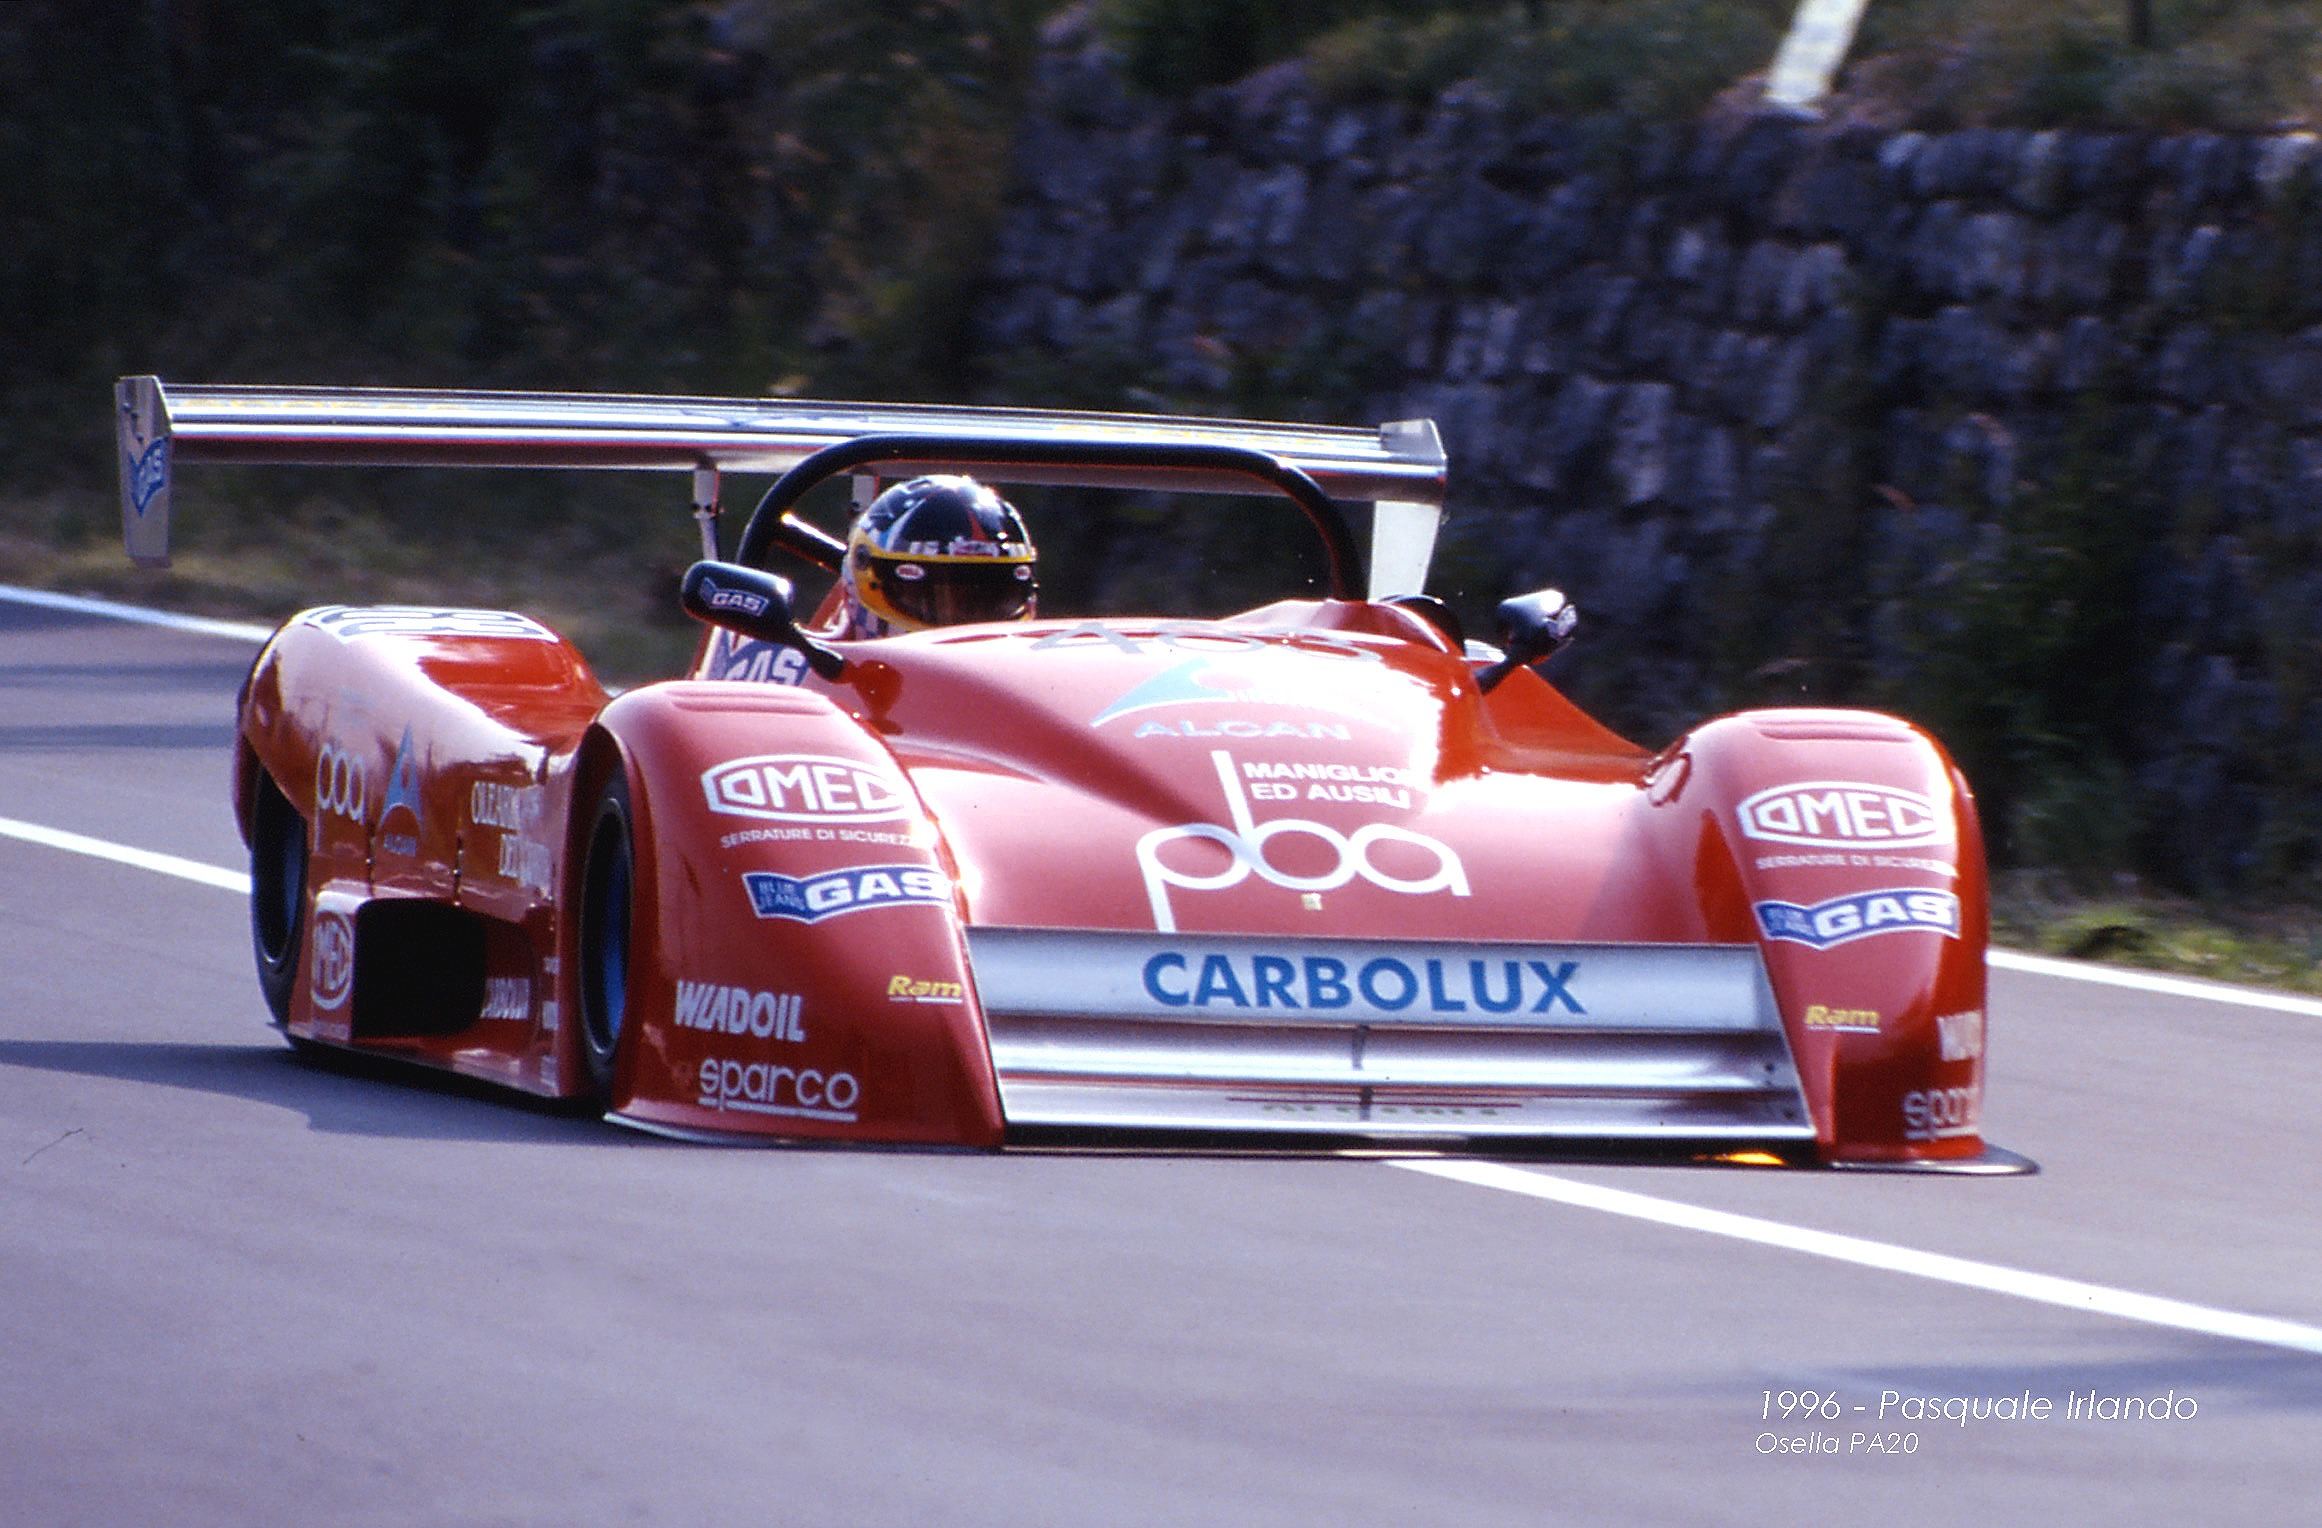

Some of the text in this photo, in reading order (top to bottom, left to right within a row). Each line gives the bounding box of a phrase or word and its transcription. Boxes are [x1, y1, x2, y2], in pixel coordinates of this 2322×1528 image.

[712, 592, 761, 612] GAS
[1135, 720, 1352, 740] ALCAN
[719, 763, 906, 812] OMEC
[1242, 762, 1414, 785] MANIGLIO
[1251, 783, 1298, 799] ED
[1755, 790, 1937, 838] OMEC
[721, 828, 812, 848] SERRATURE
[816, 828, 836, 841] DI
[1136, 750, 1471, 934] pba
[804, 871, 951, 911] GAS
[1813, 894, 1951, 938] GAS
[887, 975, 962, 997] Ram
[1142, 950, 1587, 1015] CARBOLUX
[1804, 1005, 1879, 1025] Ram
[699, 1057, 860, 1112] sparco
